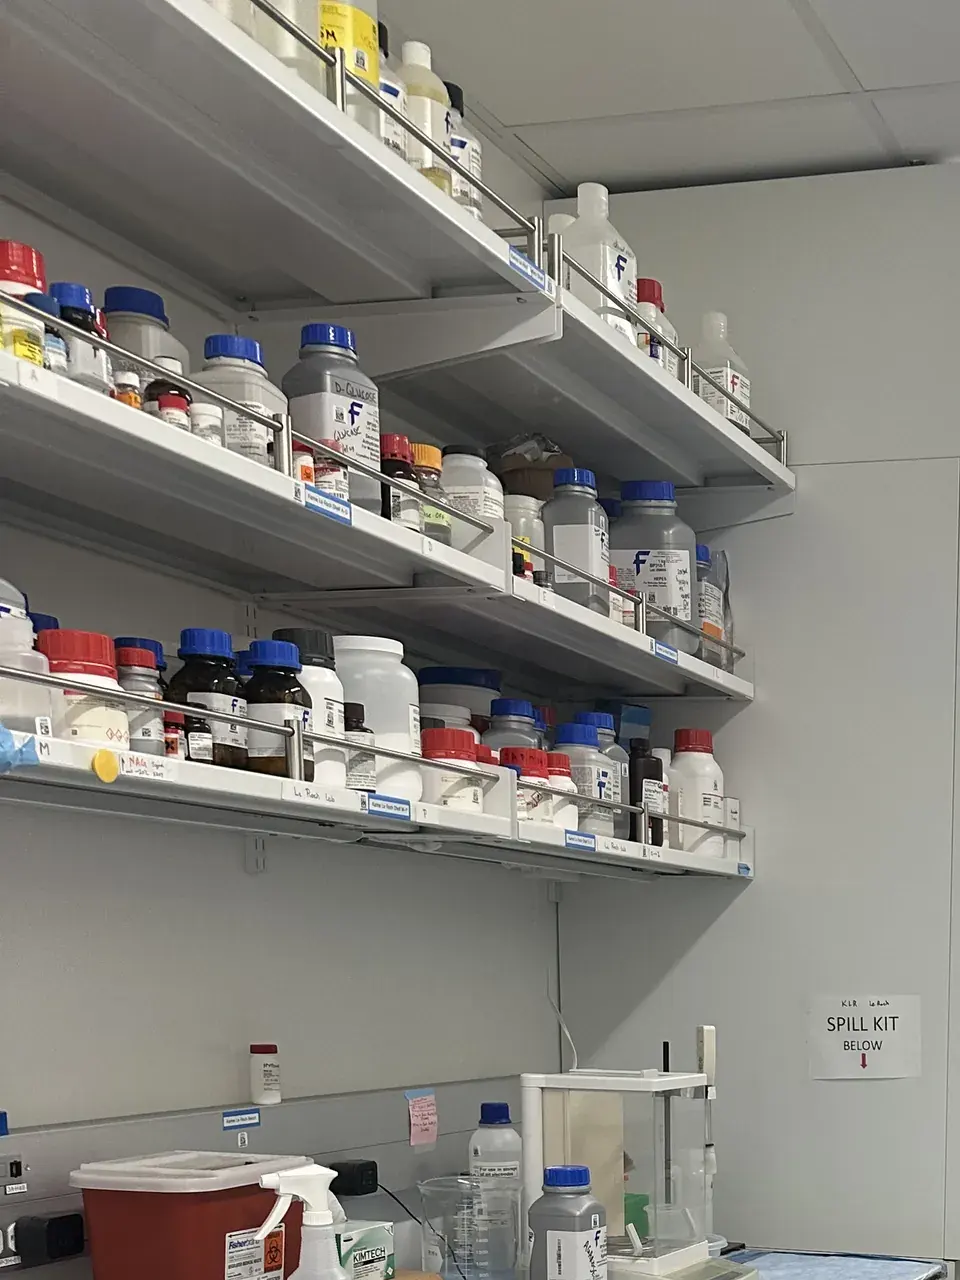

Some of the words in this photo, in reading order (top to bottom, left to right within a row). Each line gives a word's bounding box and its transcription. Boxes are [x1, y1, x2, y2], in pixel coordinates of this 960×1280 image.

[347, 401, 363, 427] F
[632, 550, 651, 577] F
[827, 1016, 869, 1032] SPILL
[873, 1016, 899, 1032] KIT
[843, 1040, 883, 1051] BELOW
[353, 1246, 386, 1263] KIMTECH
